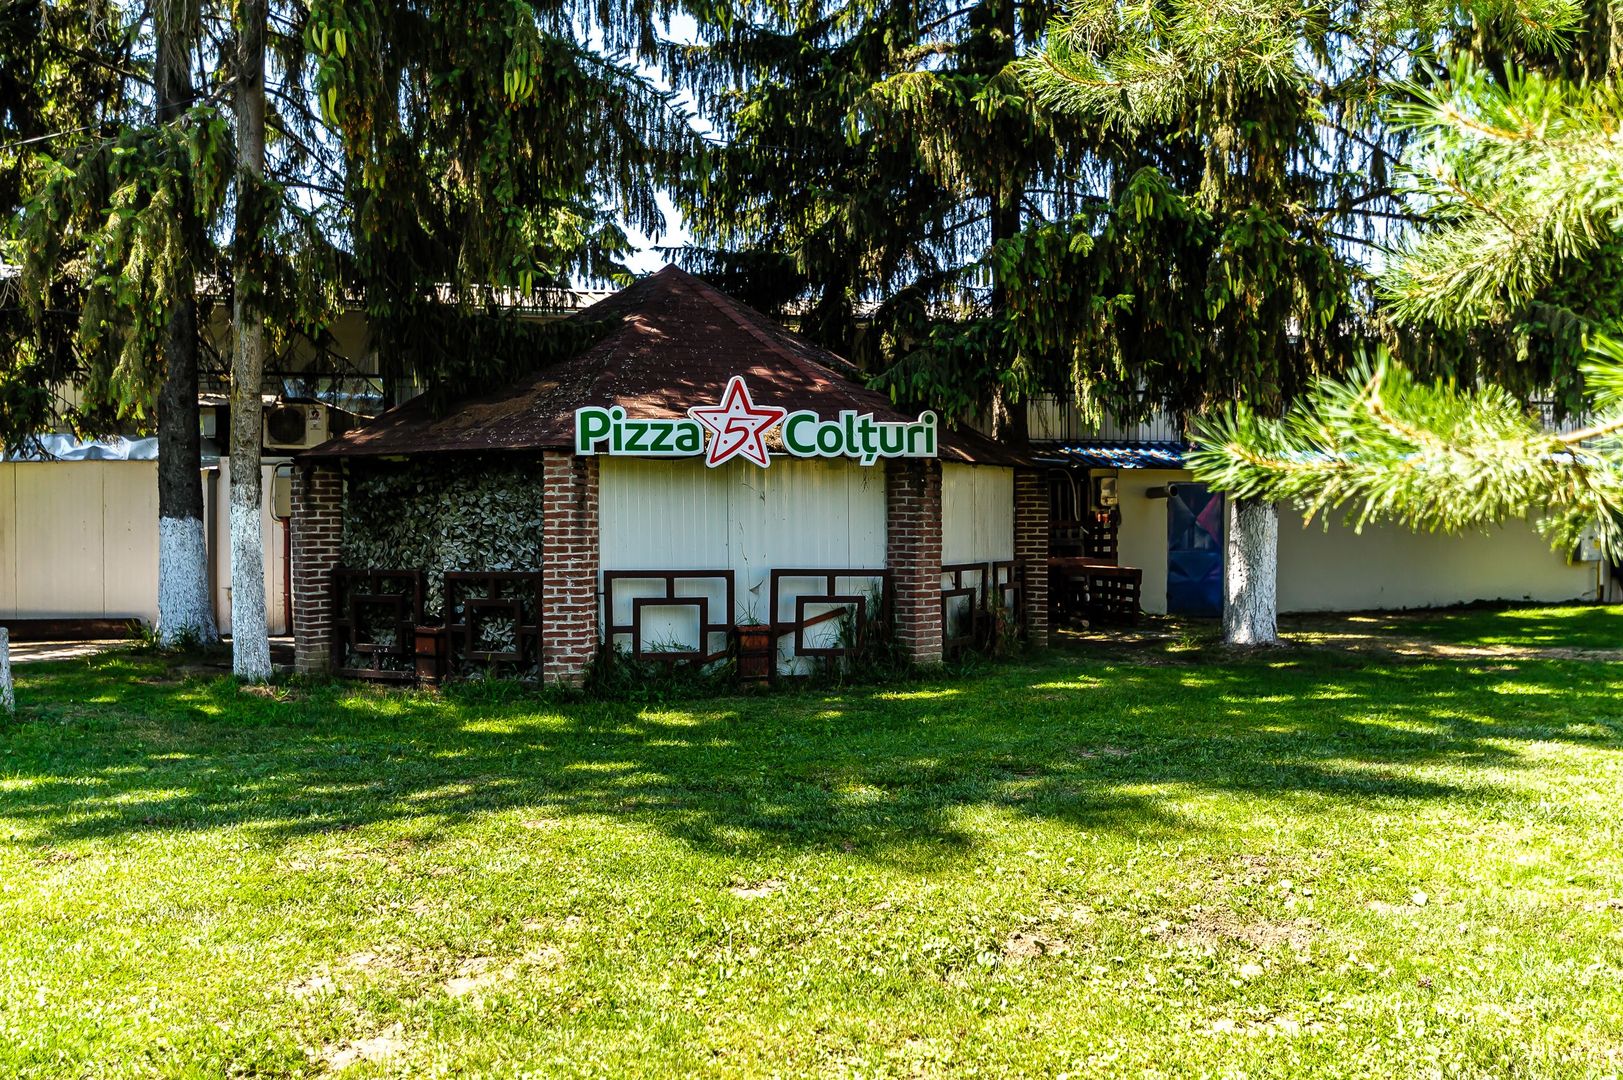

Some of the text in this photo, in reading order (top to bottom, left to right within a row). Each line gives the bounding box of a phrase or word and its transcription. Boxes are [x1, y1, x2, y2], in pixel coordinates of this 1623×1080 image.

[579, 409, 936, 462] Pizza 5 Colțuri
